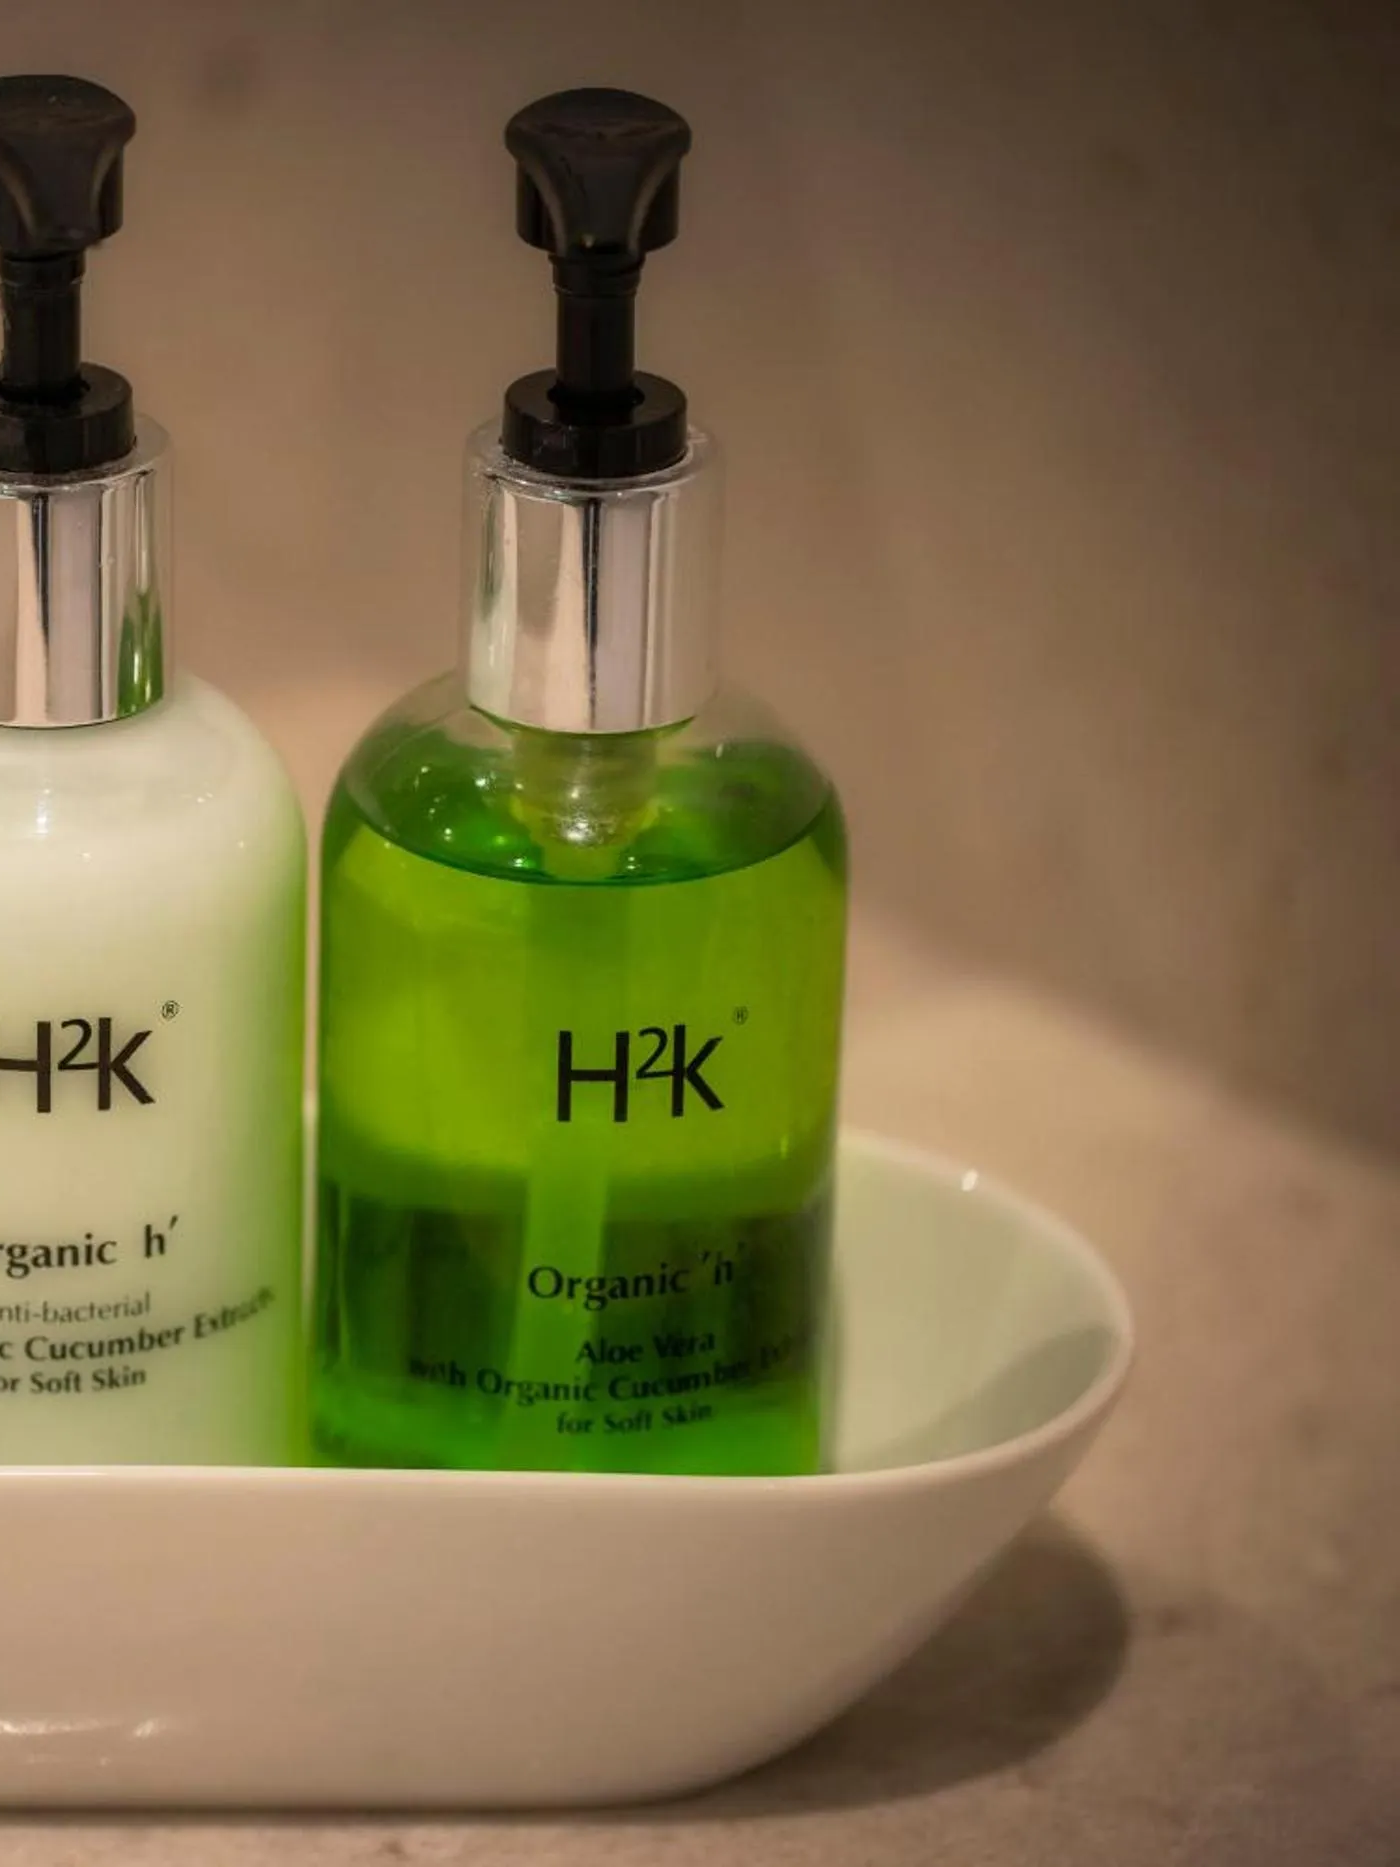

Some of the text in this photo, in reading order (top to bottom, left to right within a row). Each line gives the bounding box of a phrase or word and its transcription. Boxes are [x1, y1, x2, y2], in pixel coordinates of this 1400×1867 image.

[528, 1256, 690, 1311] Organic
[24, 1324, 186, 1362] Cucumber
[576, 1332, 715, 1365] Aloe Vera
[29, 1370, 82, 1394] Soft
[92, 1364, 147, 1391] Skin
[476, 1367, 597, 1407] Organic
[608, 1358, 750, 1400] Cucumber
[557, 1403, 712, 1434] for Soft Skin
